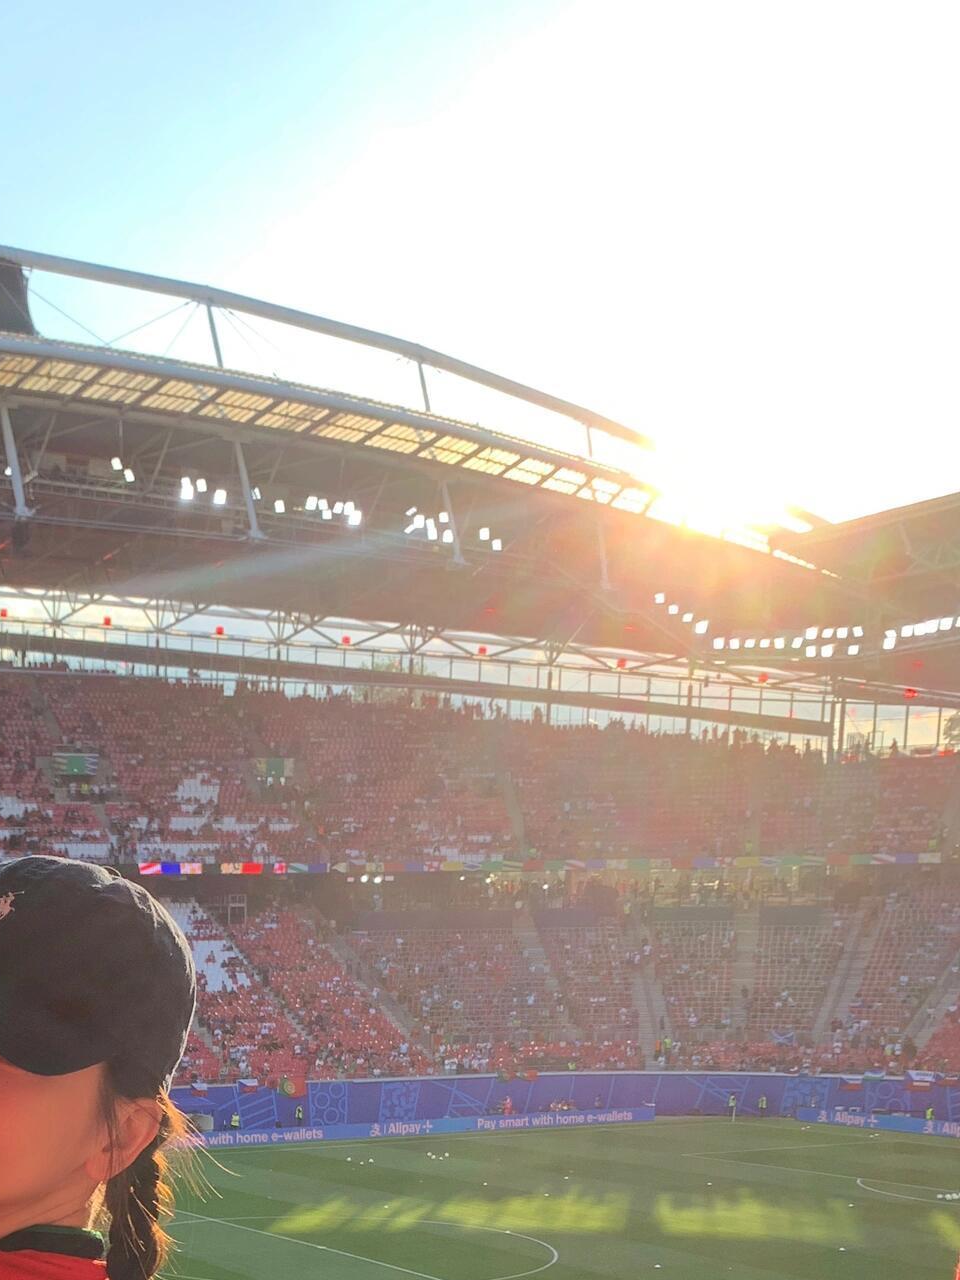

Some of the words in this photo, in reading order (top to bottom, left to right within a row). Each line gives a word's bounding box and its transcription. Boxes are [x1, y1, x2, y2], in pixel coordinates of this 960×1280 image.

[477, 1118, 496, 1130] Pay
[498, 1116, 529, 1128] smart
[531, 1115, 555, 1126] with
[556, 1113, 585, 1125] home
[586, 1111, 633, 1123] e-wallets
[208, 1133, 233, 1145] with
[236, 1132, 268, 1144] home
[271, 1128, 324, 1141] e-wallets
